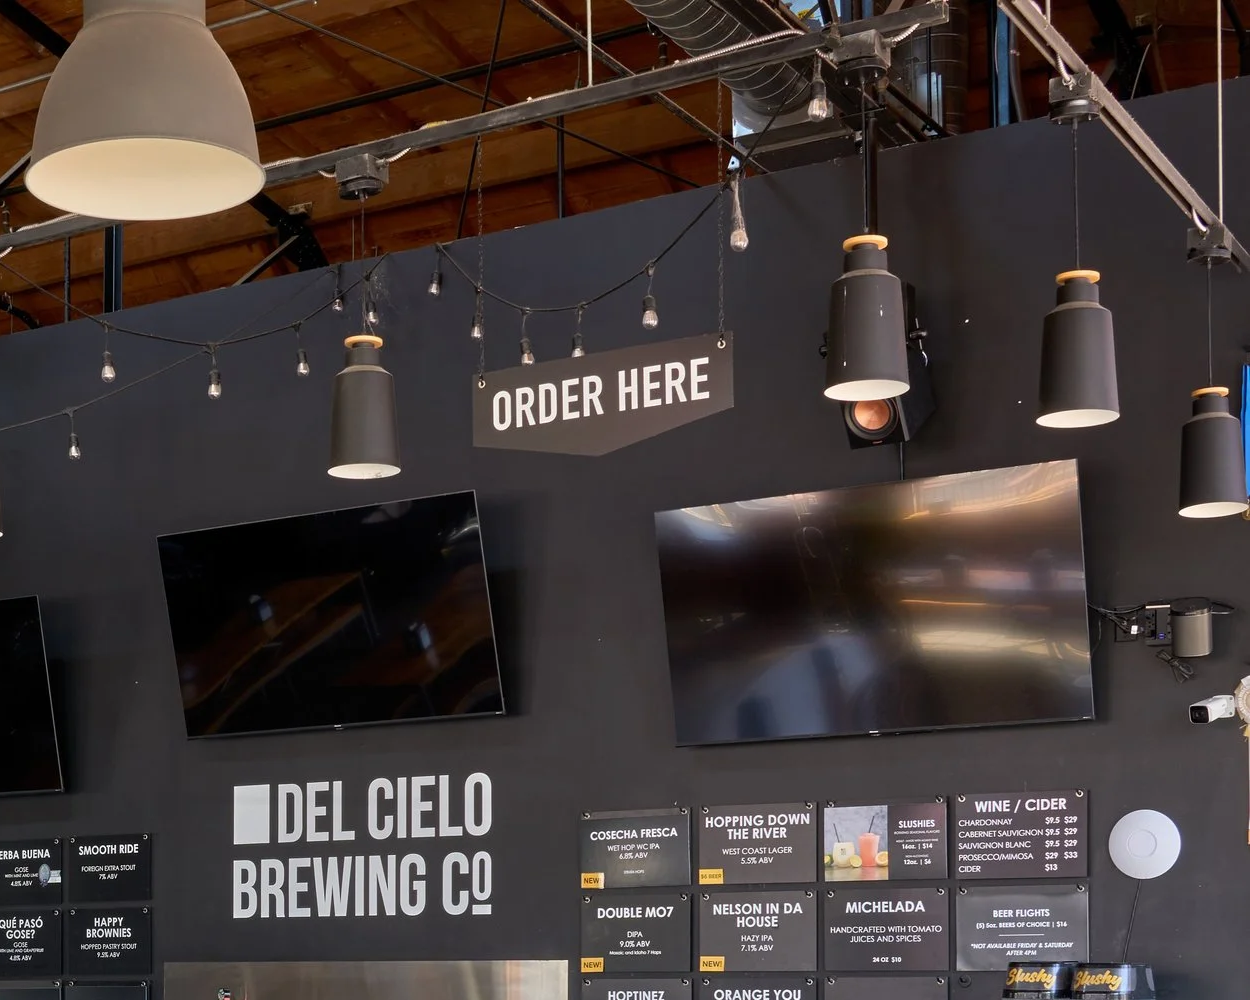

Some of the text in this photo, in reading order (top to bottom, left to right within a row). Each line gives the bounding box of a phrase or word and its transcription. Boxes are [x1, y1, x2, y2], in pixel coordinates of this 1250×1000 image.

[492, 357, 710, 431] ORDER HERE
[278, 772, 492, 843] DEL CIELO
[975, 798, 1067, 813] WINE CIDER
[705, 813, 810, 828] HOPPING DOWN
[898, 819, 935, 829] SLUSHIES
[958, 816, 1078, 827] CHARDONNAY $9.5 $29
[590, 827, 678, 841] COSECHA FRESCA
[727, 827, 787, 840] THE RIVER
[958, 828, 1078, 838] CABERNET SAUVIGNON $9.5 $29
[607, 844, 620, 852] WET
[621, 843, 636, 851] HOP
[649, 842, 660, 850] IPA
[958, 839, 1078, 850] SAUVIGNON BLANC $9.5 $29
[22, 849, 50, 859] BUENA
[79, 844, 139, 856] SMOOTH RIDE
[741, 847, 766, 855] COAST
[768, 846, 793, 854] LAGER
[619, 852, 634, 860] 6.8%
[741, 857, 757, 865] 5.5%
[958, 851, 1078, 861] PROSECCO/MIMOSA $29 $33
[120, 864, 136, 872] STOUT
[958, 864, 1058, 873] CIDER $13
[233, 853, 426, 918] BREWING
[597, 906, 674, 919] DOUBLE MO7
[712, 902, 803, 916] NELSON IN DA
[845, 901, 926, 914] MICHELADA
[993, 909, 1050, 918] BEER FLIGHTS
[19, 916, 43, 929] PASÓ
[94, 917, 124, 927] HAPPY
[736, 916, 778, 928] HOUSE
[6, 929, 36, 939] GOSE?
[86, 928, 132, 938] BROWNIES
[830, 925, 942, 934] HANDCRAFTED WITH TOMATO
[761, 934, 773, 942] IPA
[850, 934, 922, 943] JUICES AND SPICES
[619, 940, 635, 948] 9.0%
[1006, 967, 1057, 989] Slushy
[1073, 968, 1123, 991] Slushy
[714, 989, 802, 1000] ORANGE YOU
